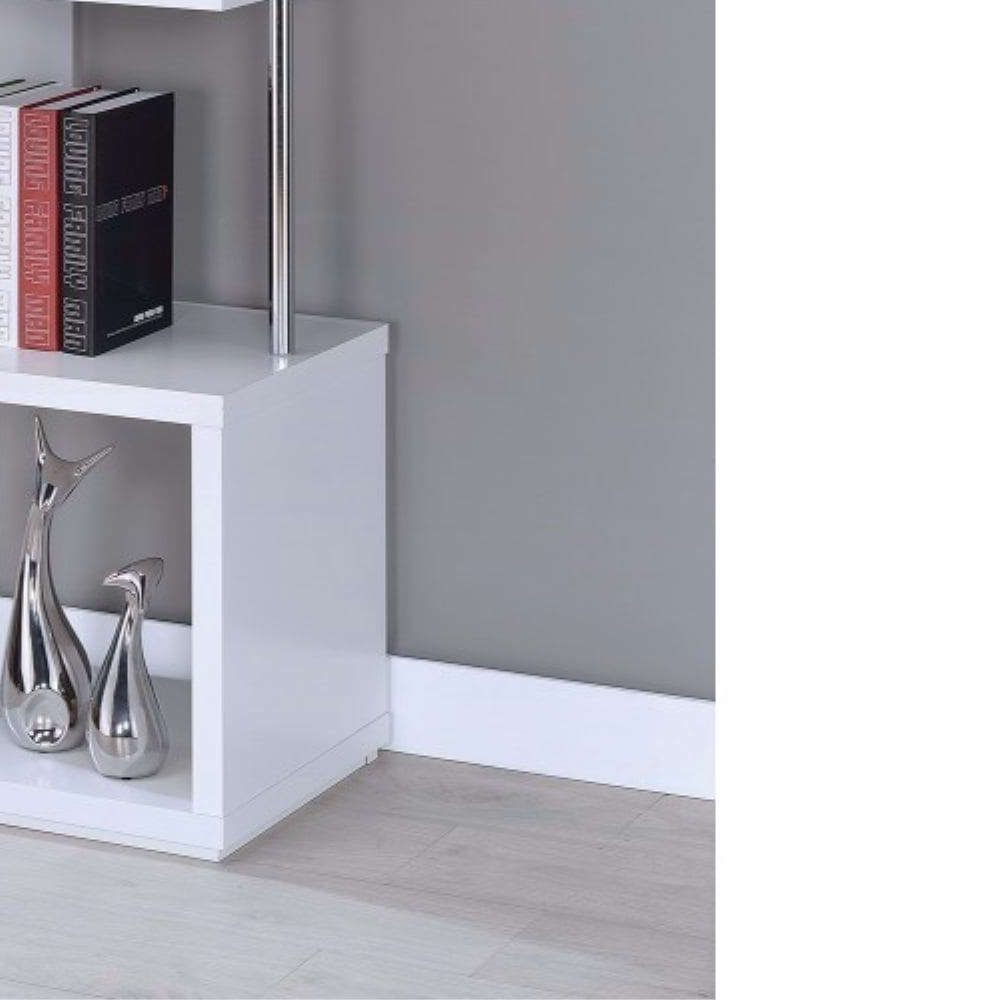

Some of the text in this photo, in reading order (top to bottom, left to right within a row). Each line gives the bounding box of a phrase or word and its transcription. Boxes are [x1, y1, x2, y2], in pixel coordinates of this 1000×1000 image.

[23, 199, 50, 285] FAMILY
[63, 203, 89, 291] FAMILY
[23, 292, 50, 347] MAN
[62, 297, 88, 353] MAN
